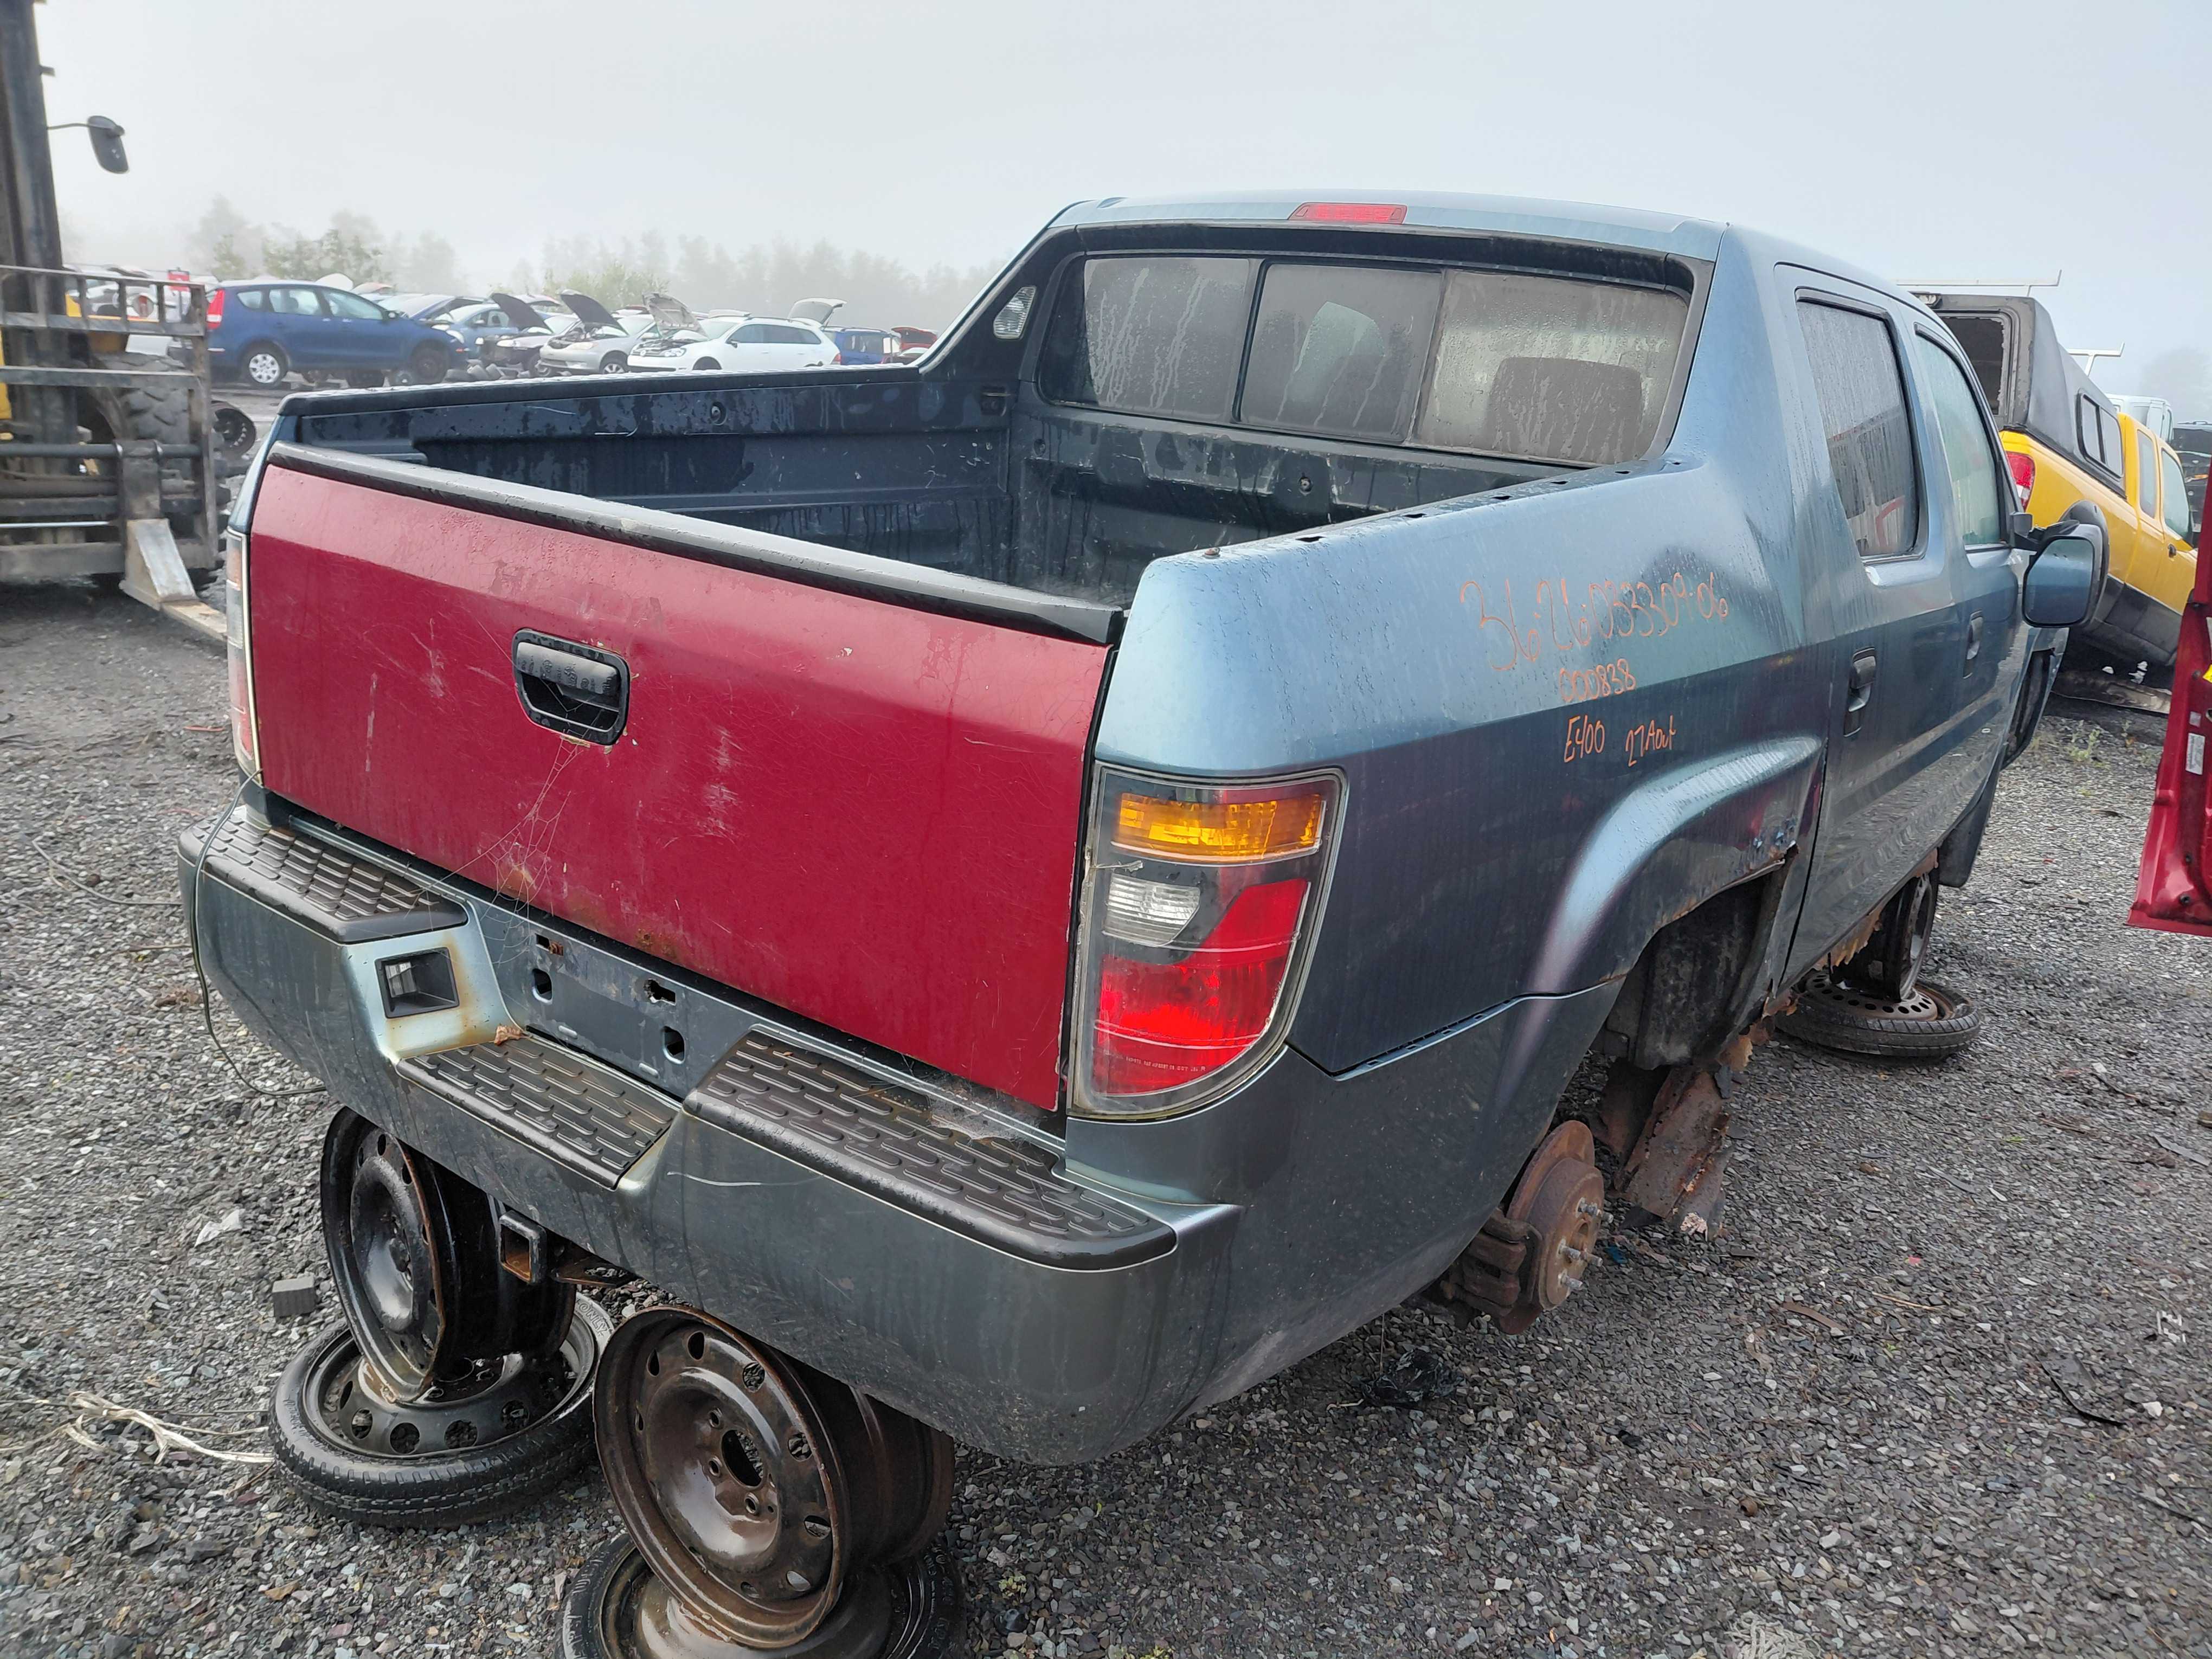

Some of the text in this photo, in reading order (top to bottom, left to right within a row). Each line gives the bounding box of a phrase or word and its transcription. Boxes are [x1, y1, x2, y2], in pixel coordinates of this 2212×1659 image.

[1559, 658, 1636, 703] 000838
[1564, 715, 1606, 763] E400
[579, 1303, 608, 1334] ONLY
